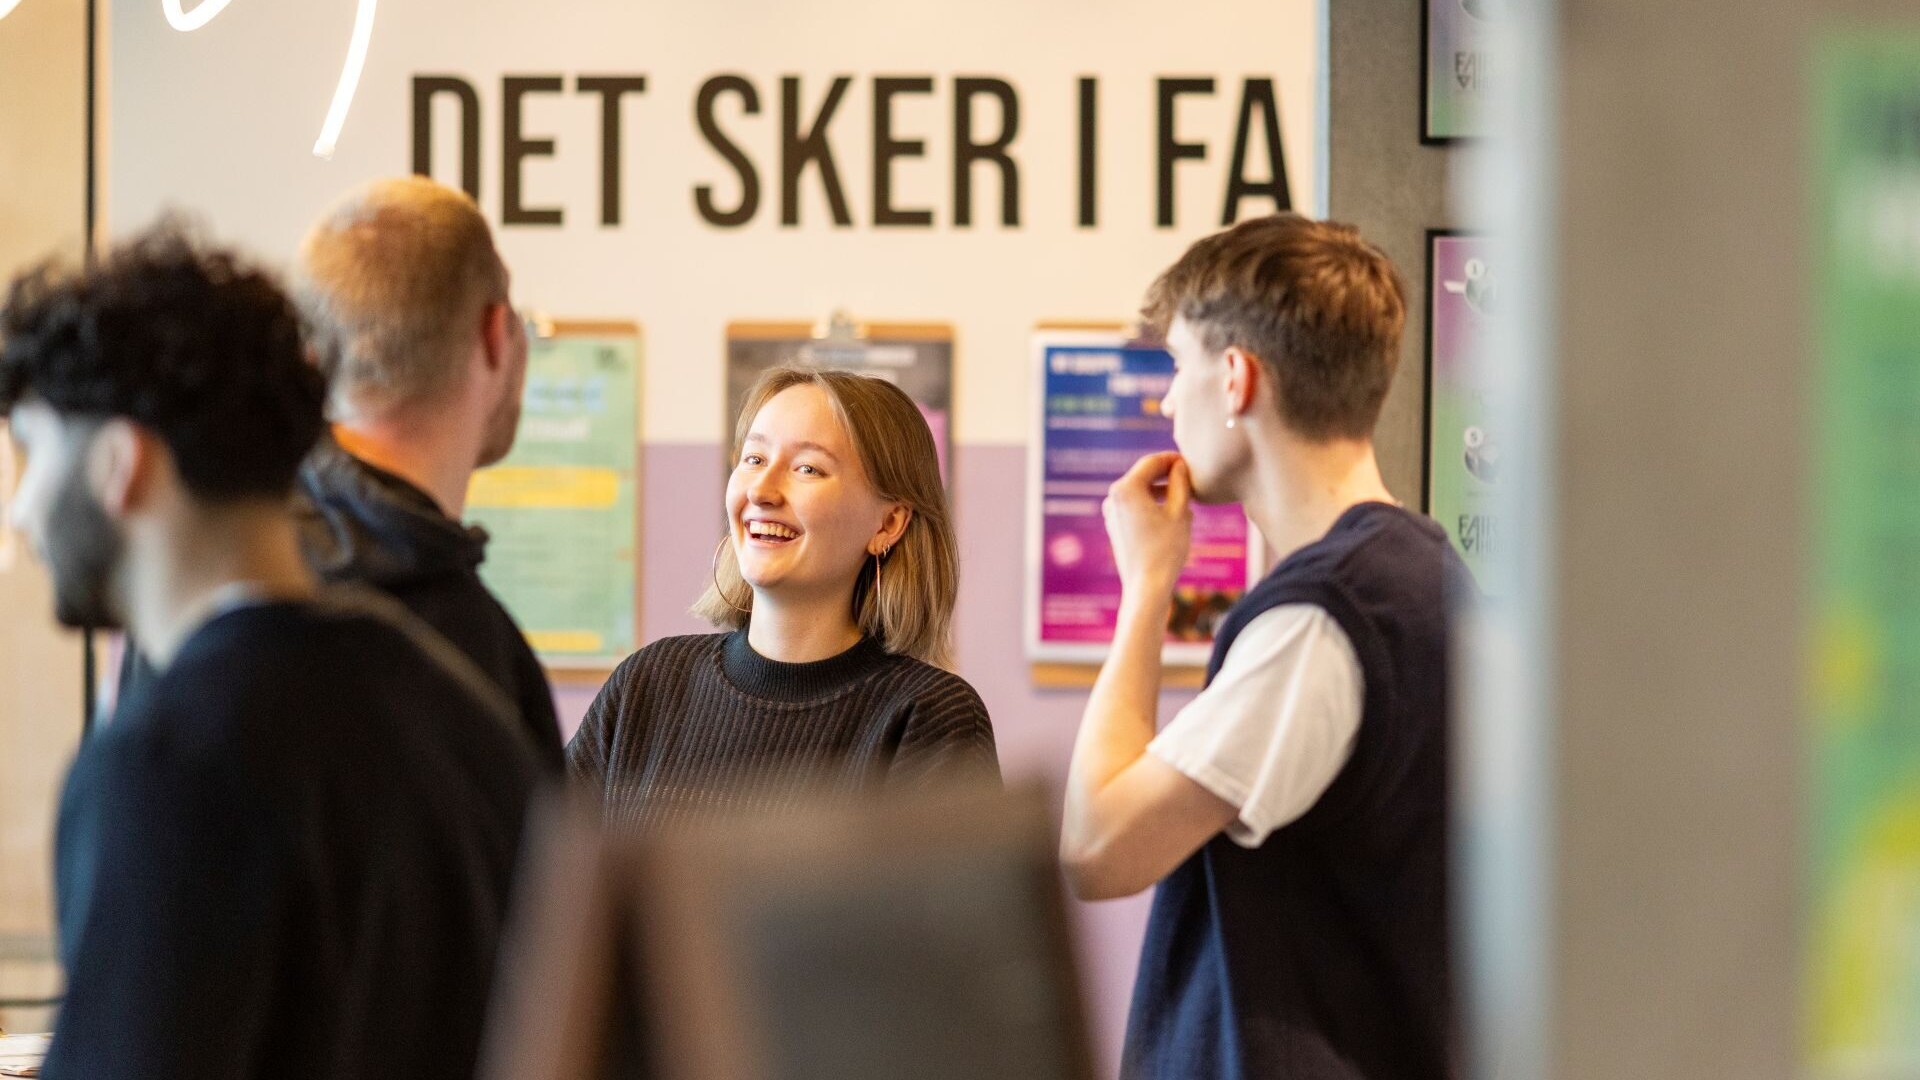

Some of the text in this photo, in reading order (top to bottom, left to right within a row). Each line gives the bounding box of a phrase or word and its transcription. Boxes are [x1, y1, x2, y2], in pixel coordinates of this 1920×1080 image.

[411, 74, 1292, 227] DET SKER I FA
